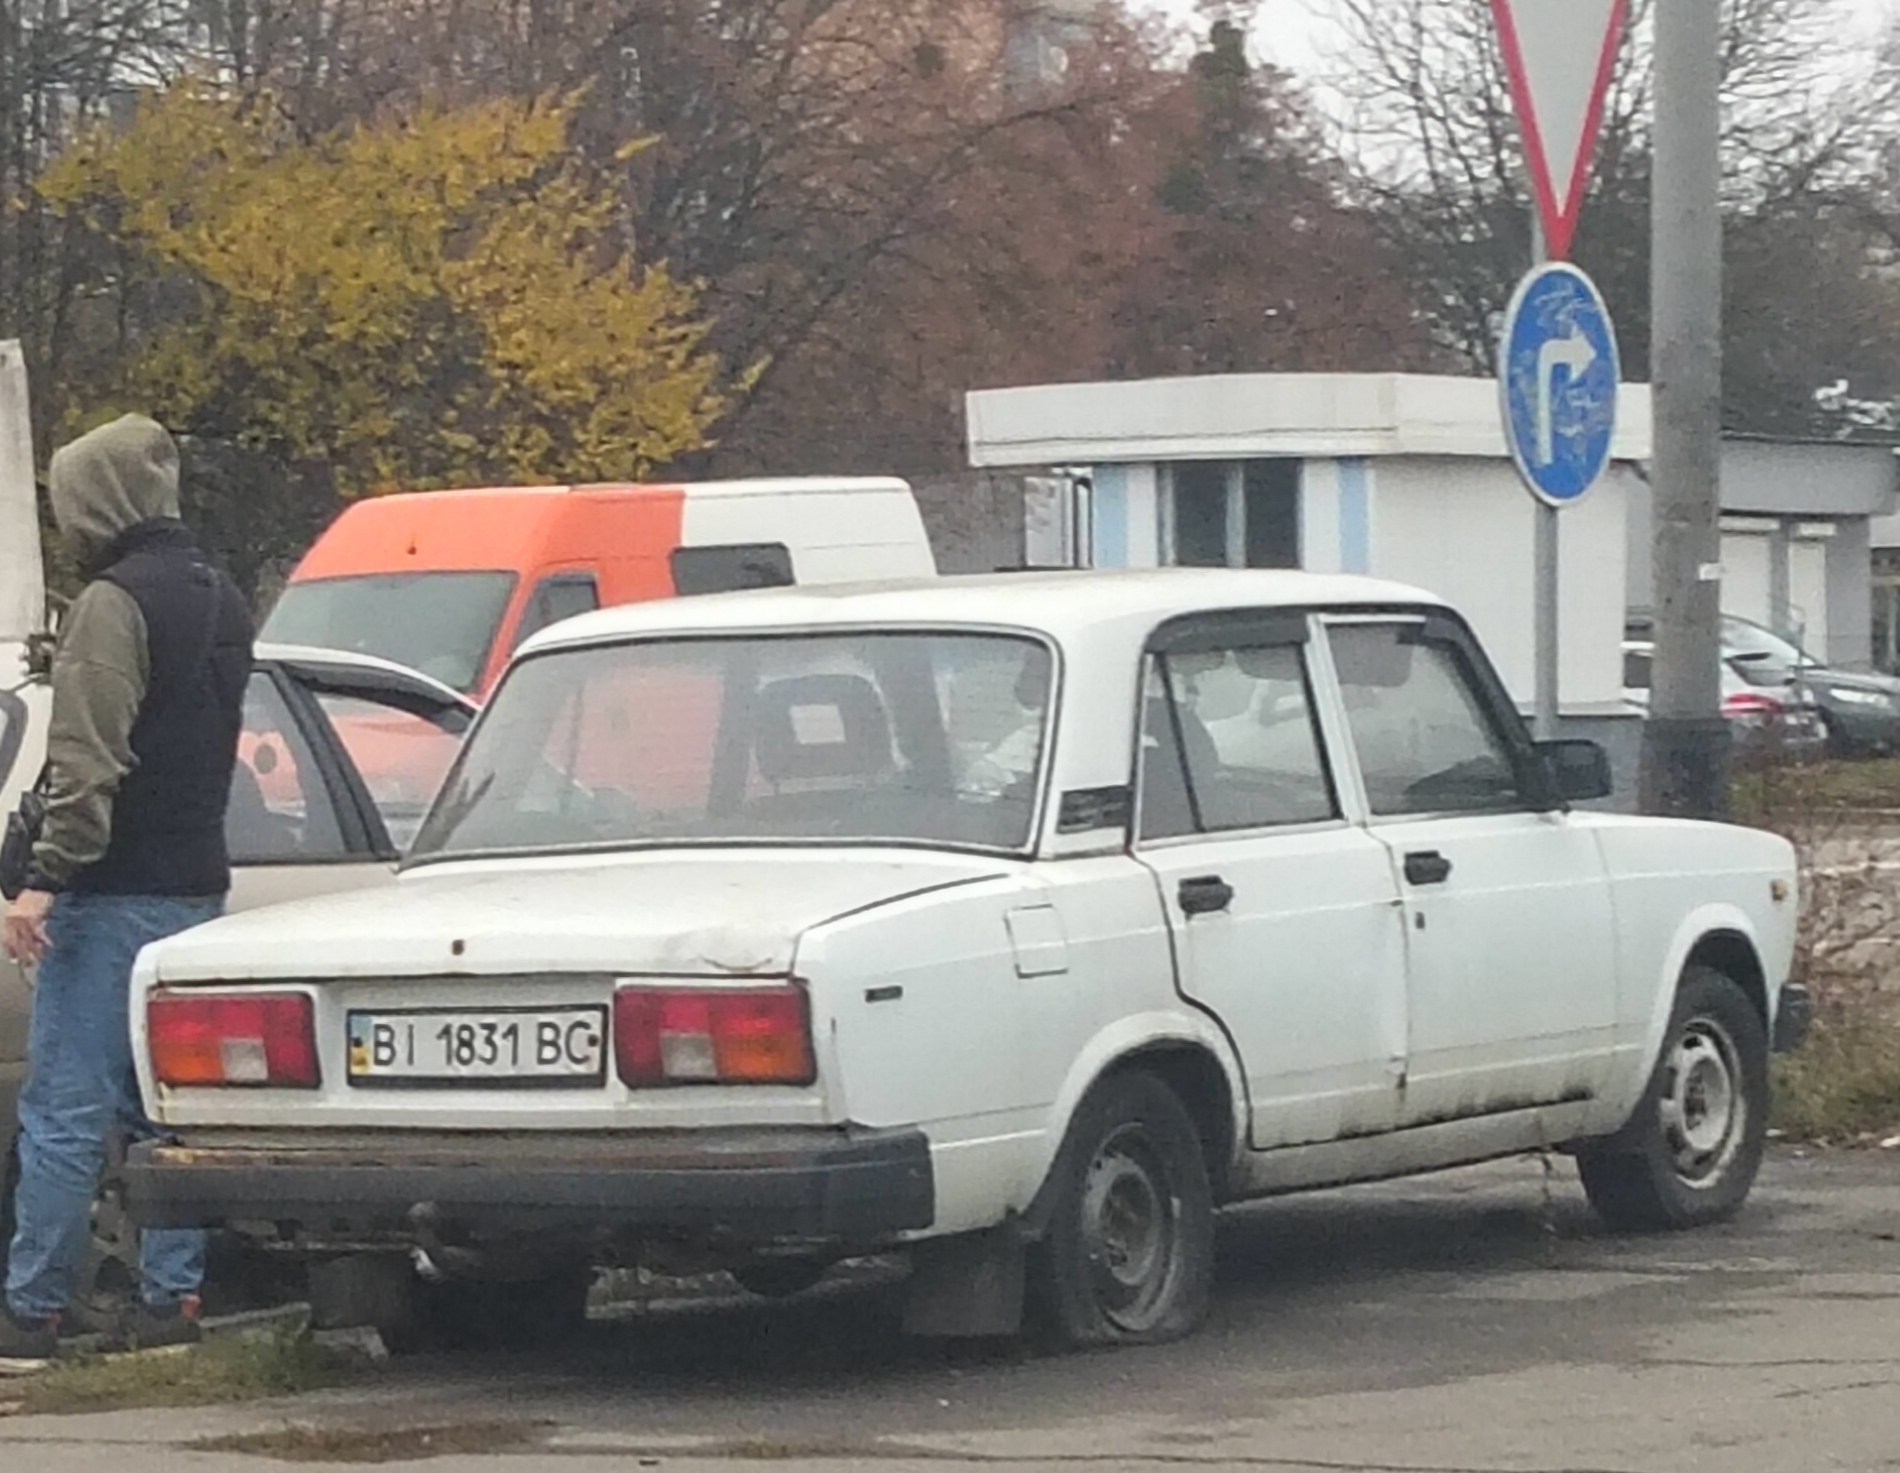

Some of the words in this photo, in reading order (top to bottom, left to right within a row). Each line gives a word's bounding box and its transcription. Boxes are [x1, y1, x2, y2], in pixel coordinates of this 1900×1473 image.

[373, 1023, 414, 1066] BI
[436, 1022, 519, 1066] 1831
[537, 1020, 591, 1065] BC
